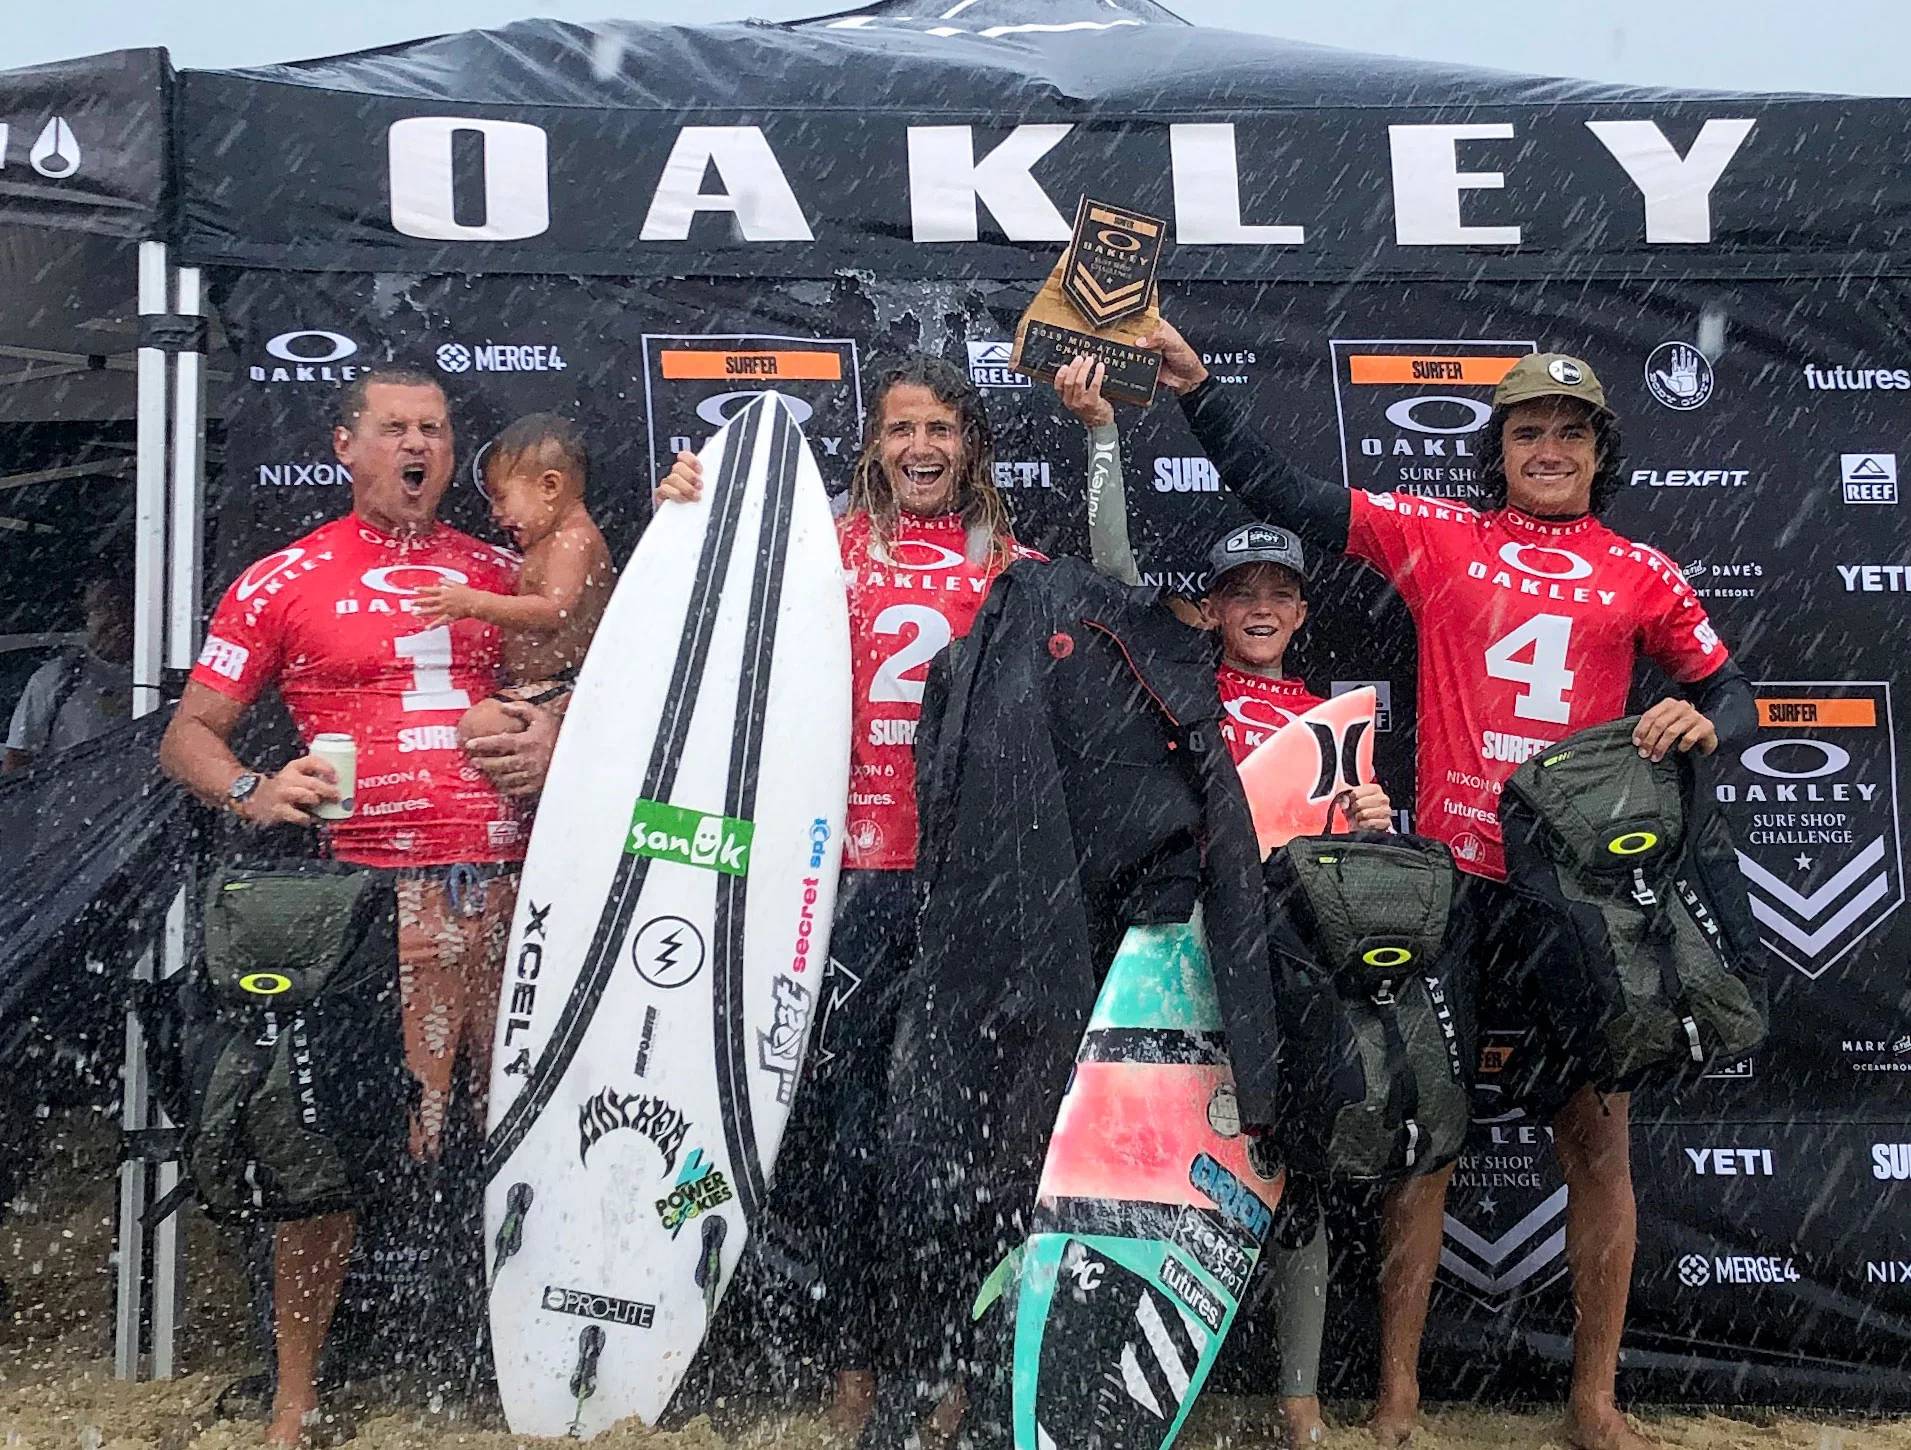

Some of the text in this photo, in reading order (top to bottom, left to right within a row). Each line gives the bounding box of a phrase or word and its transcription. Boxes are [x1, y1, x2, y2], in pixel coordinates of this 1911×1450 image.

[388, 115, 1757, 246] OAKLEY
[1082, 241, 1149, 266] OAKLEY
[1031, 326, 1156, 366] 2019 MID-ATLANTIC
[475, 344, 567, 372] MERGE4
[725, 356, 778, 375] SURFER
[1203, 349, 1257, 365] DAVE'S
[250, 365, 371, 382] OAKLE
[1216, 375, 1248, 384] SORT
[1411, 360, 1463, 380] SURFER
[1360, 438, 1475, 457] OAKL
[259, 463, 354, 487] NIXON
[991, 461, 1051, 488] ETI
[1399, 467, 1478, 482] SURF SH
[1396, 484, 1492, 499] CHALLEN
[1847, 485, 1894, 500] REEF
[1712, 562, 1763, 577] DAVE'S
[1143, 571, 1208, 593] NIX
[1466, 560, 1617, 606] OAKLEY
[1714, 588, 1755, 598] RESORT
[869, 604, 952, 704] 2
[394, 625, 471, 712] 1
[1484, 613, 1576, 726] 4
[1768, 702, 1818, 722] SURFER
[851, 764, 882, 777] XON
[1446, 770, 1490, 793] NIXON
[848, 791, 896, 806] tures.
[1715, 783, 1877, 802] OAKLEY
[1753, 814, 1847, 828] SURF SHOP
[1749, 830, 1853, 845] CHALLENGE
[793, 877, 820, 973] secret
[1432, 977, 1461, 1076] OAKLEY
[1842, 1040, 1886, 1052] MARK
[1484, 1155, 1535, 1170] SHOP
[1684, 1147, 1773, 1176] YETI
[1452, 1172, 1541, 1187] ALLENGE
[655, 1171, 727, 1217] POWER
[661, 1186, 733, 1230] COOKIES
[1213, 1260, 1244, 1294] SPOT
[1715, 1256, 1800, 1284] MERGE4
[1160, 1258, 1219, 1329] futures.
